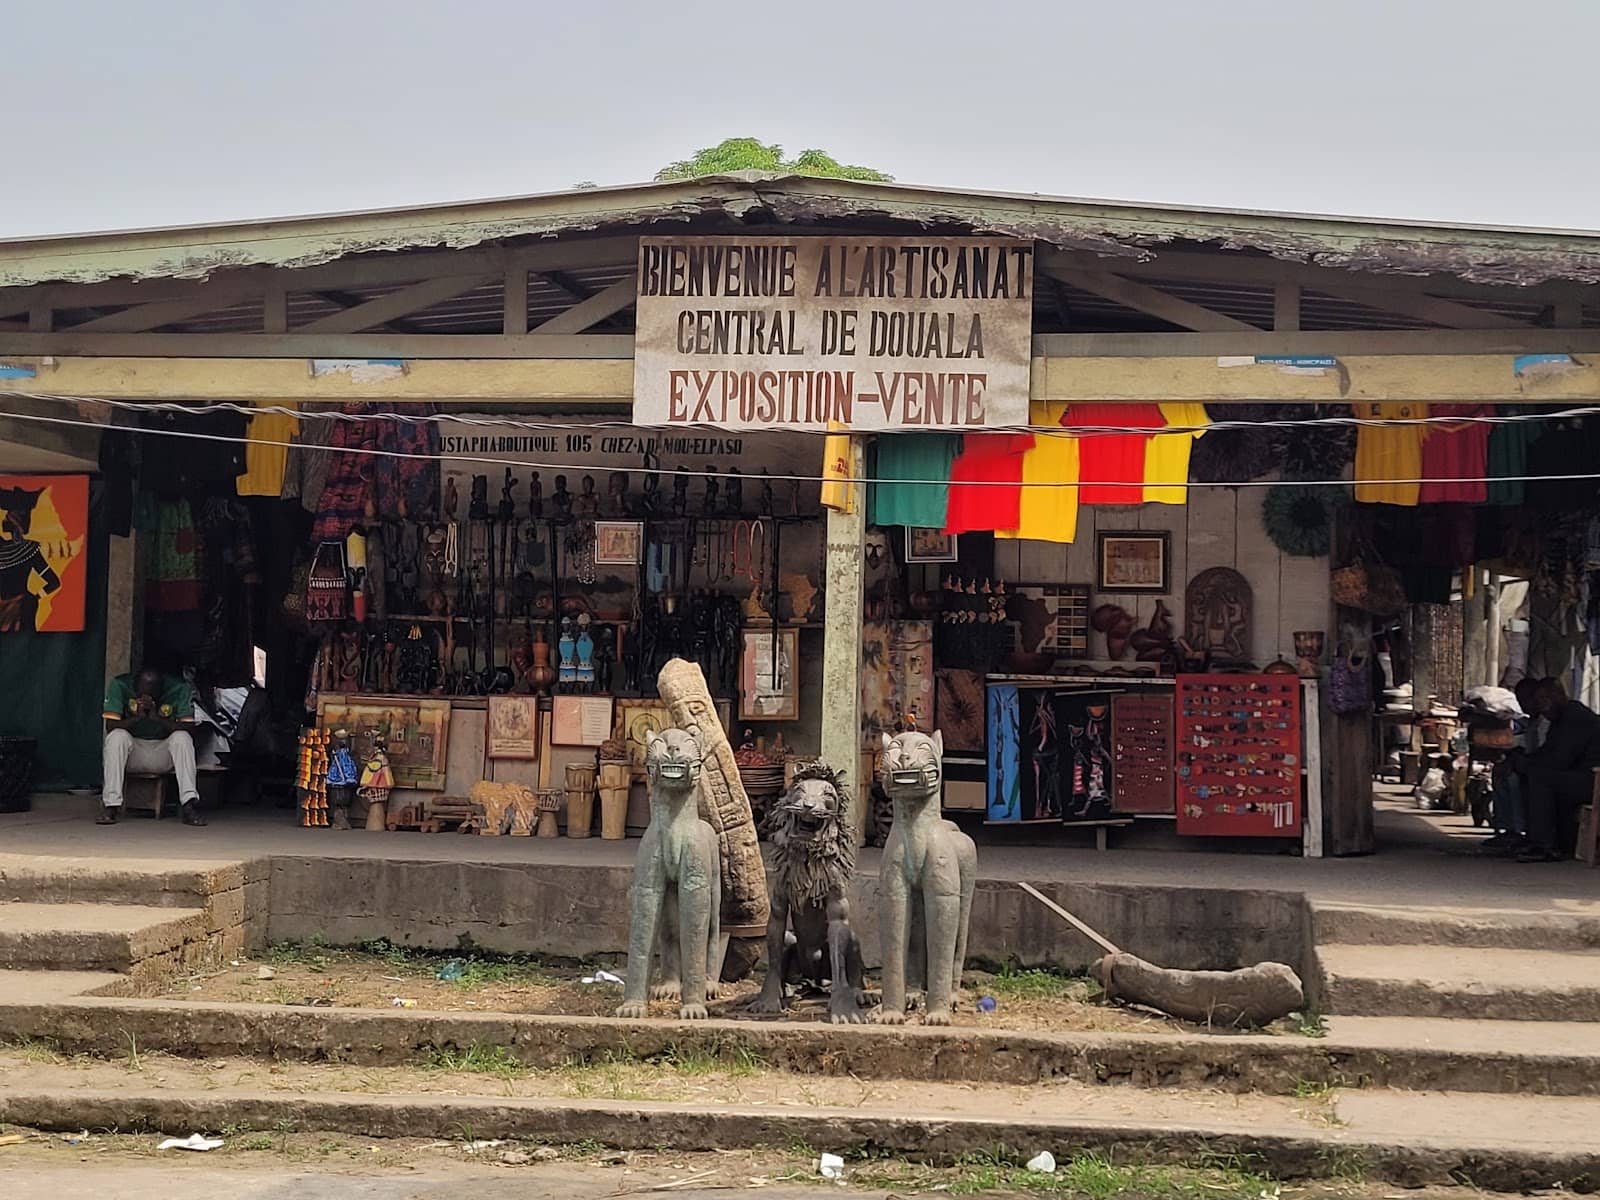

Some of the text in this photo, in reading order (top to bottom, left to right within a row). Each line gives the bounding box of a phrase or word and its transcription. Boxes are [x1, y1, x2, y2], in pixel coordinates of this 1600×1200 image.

[640, 245, 797, 297] BIENVENUE
[676, 310, 985, 359] CENTRAL DE DOUALA
[566, 434, 592, 453] 105
